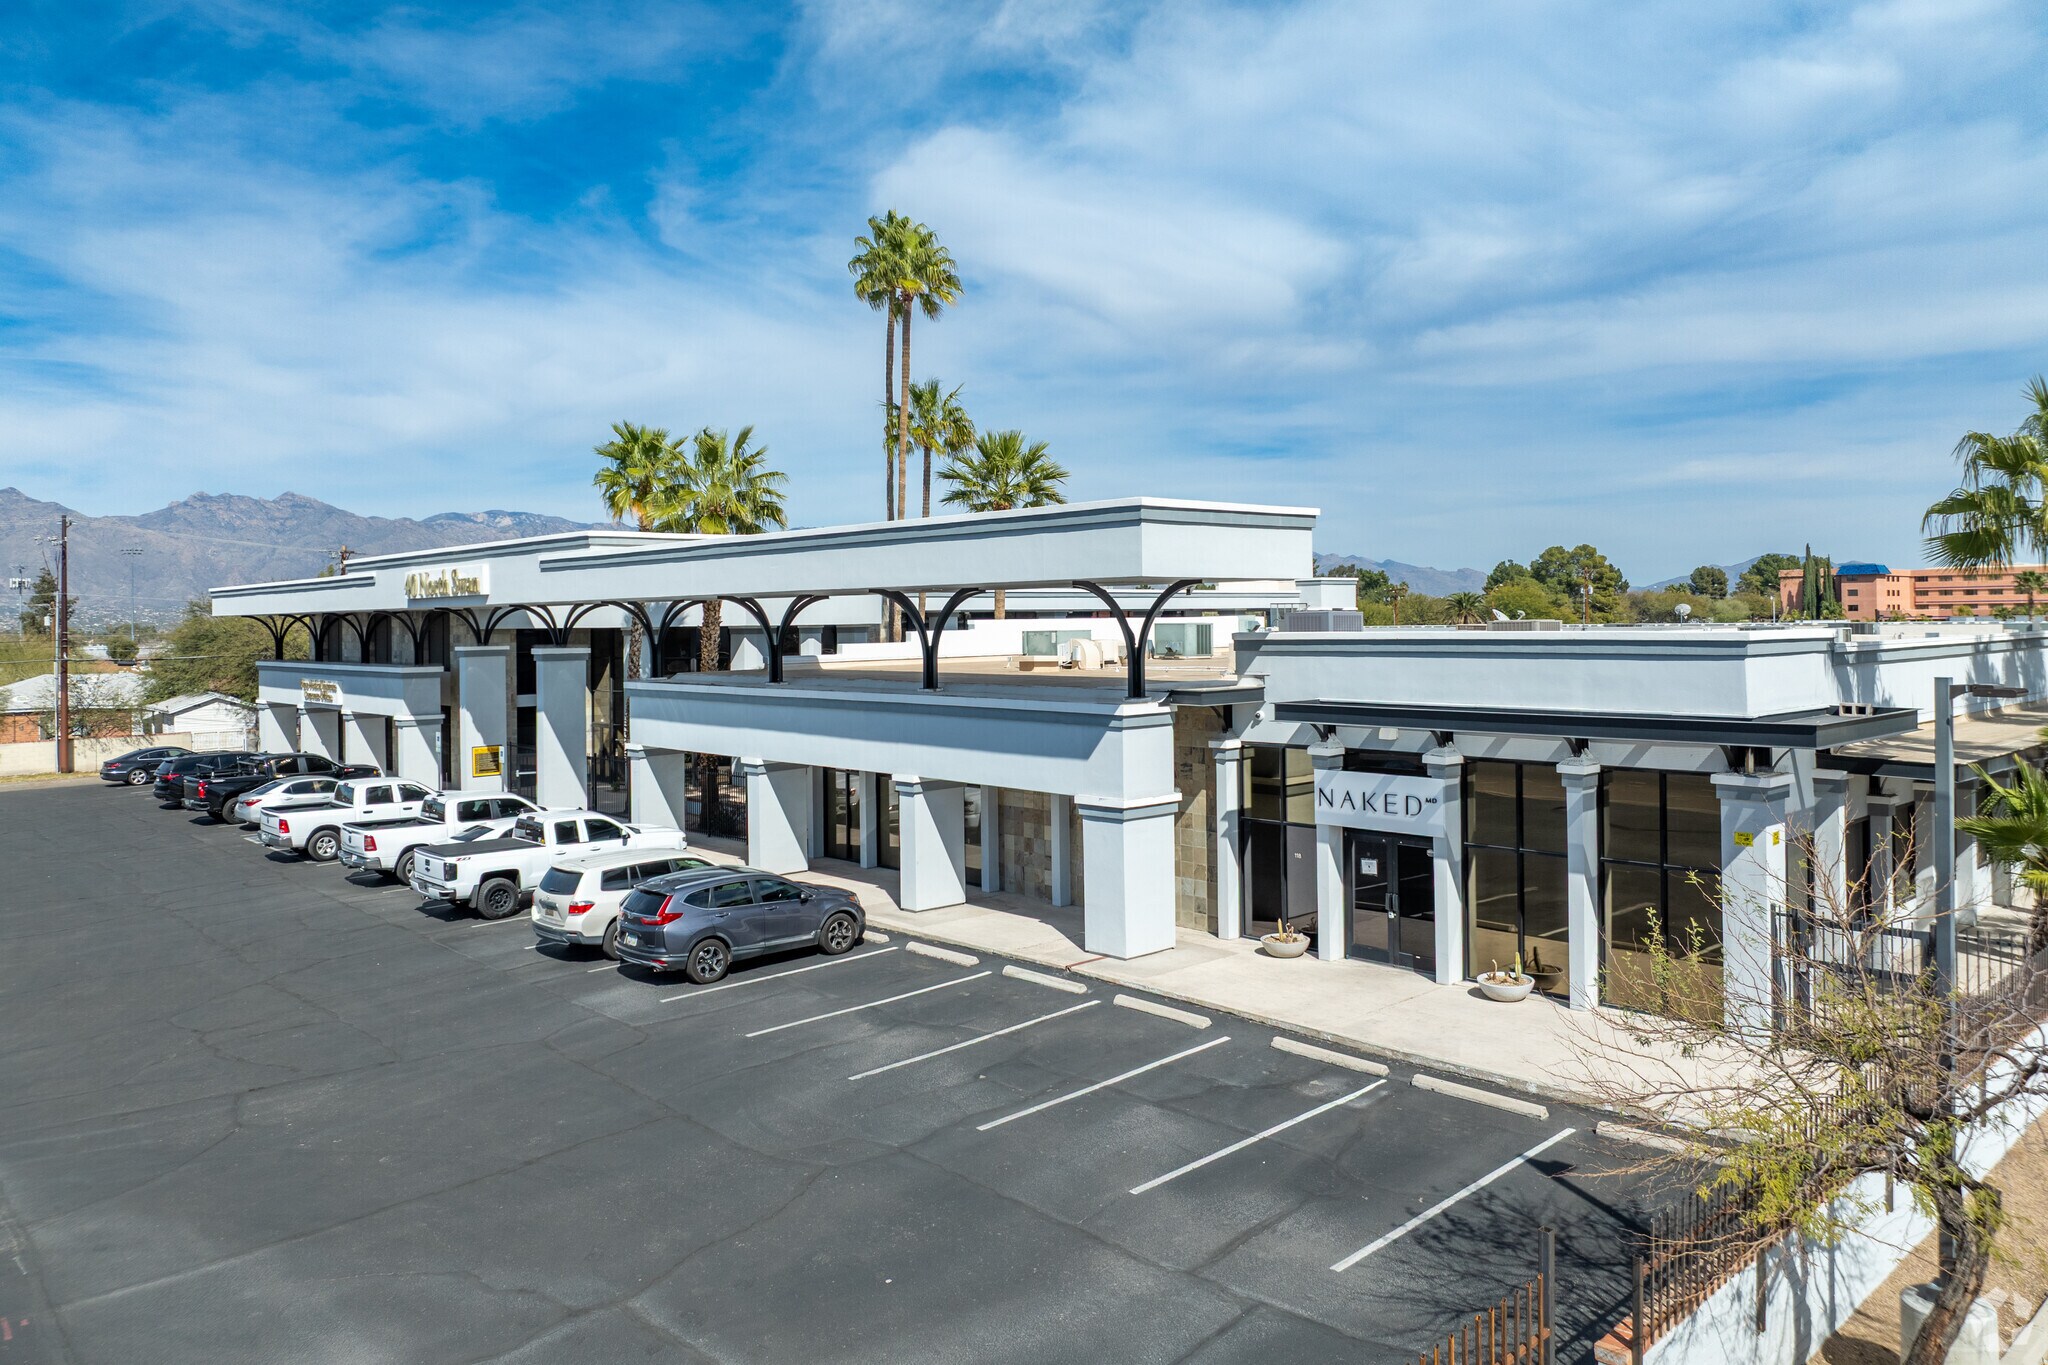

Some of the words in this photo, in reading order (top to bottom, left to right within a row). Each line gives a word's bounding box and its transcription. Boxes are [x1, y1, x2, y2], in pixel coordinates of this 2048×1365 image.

[404, 573, 418, 598] 40
[419, 569, 450, 598] North
[451, 569, 481, 597] Swan
[1318, 787, 1423, 816] NAKED
